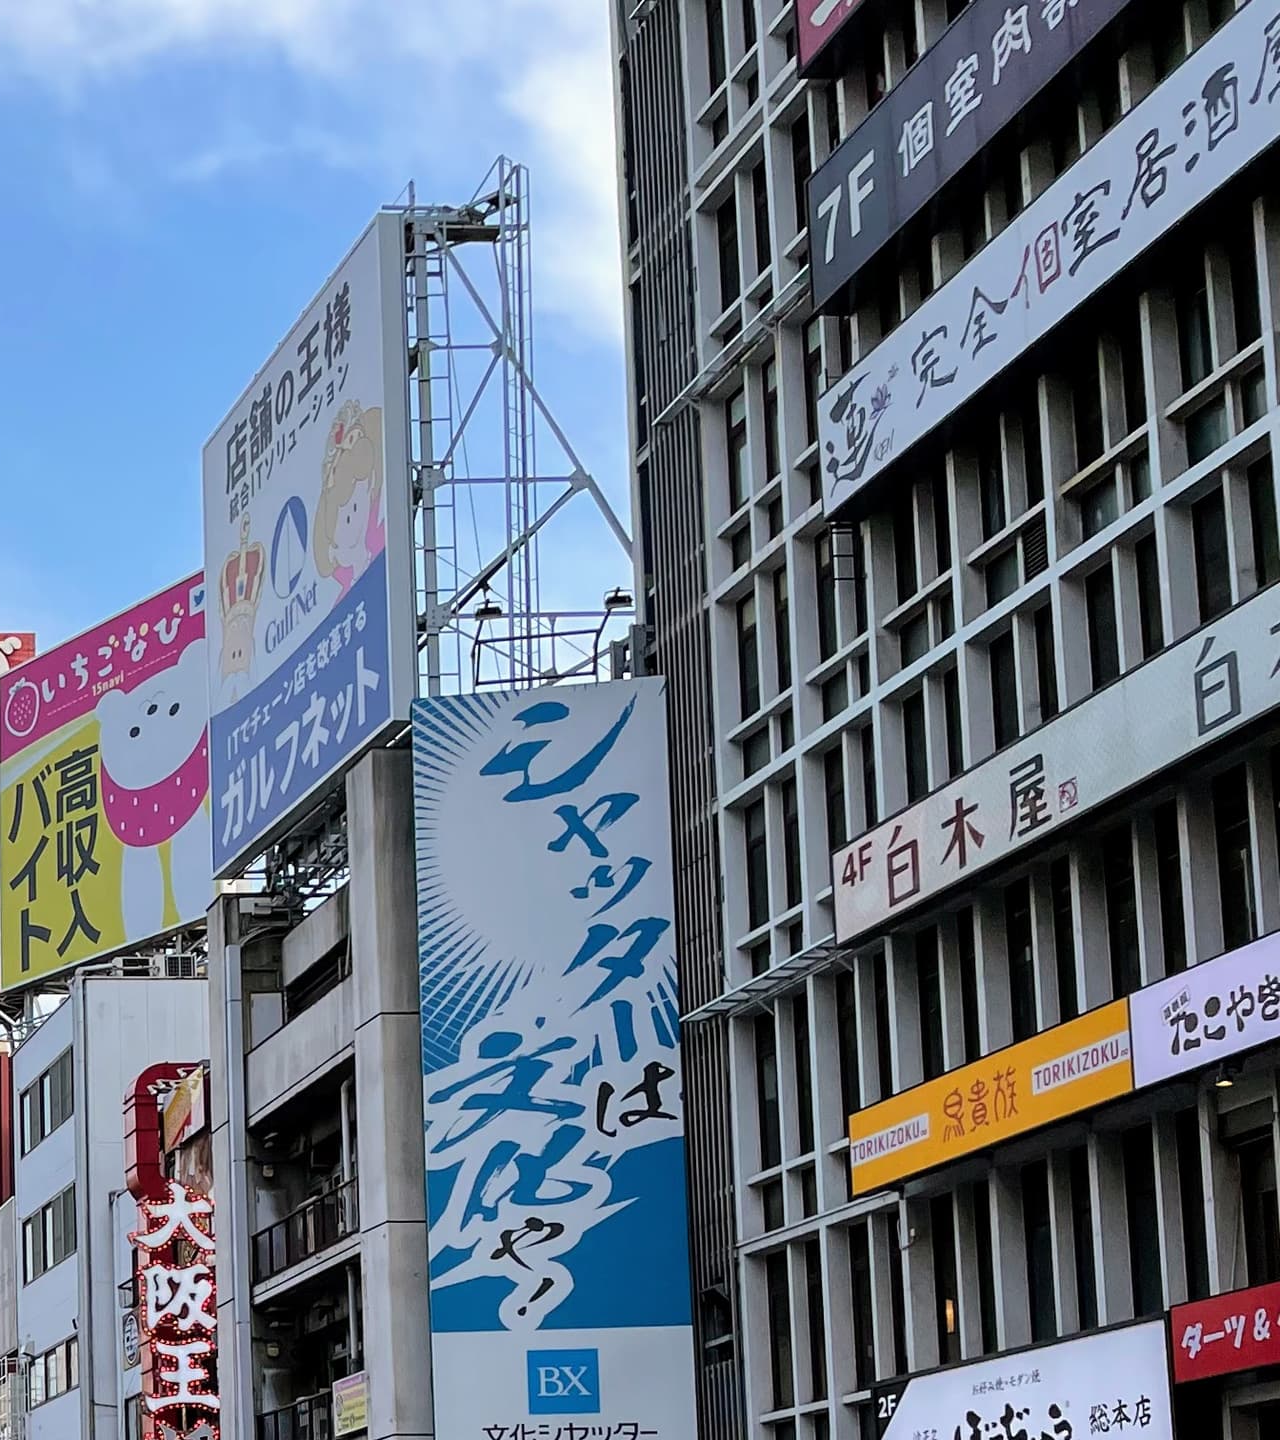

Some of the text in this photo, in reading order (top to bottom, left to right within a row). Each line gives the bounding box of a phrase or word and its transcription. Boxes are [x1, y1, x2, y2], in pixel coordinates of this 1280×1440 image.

[815, 148, 876, 266] 7F
[225, 281, 351, 495] 店舗の王様
[41, 602, 184, 703] いちごなび
[91, 674, 125, 697] 15navi
[221, 645, 381, 848] ガルフネット
[7, 764, 52, 973] バイト
[54, 743, 101, 957] 高収入
[840, 753, 1053, 908] 4F 白木屋
[1033, 1038, 1120, 1090] TORIKIZOKU
[851, 1122, 920, 1163] TORIKIZOKU
[536, 1364, 589, 1399] BX
[878, 1394, 897, 1419] 2F
[1088, 1394, 1152, 1436] 総本店
